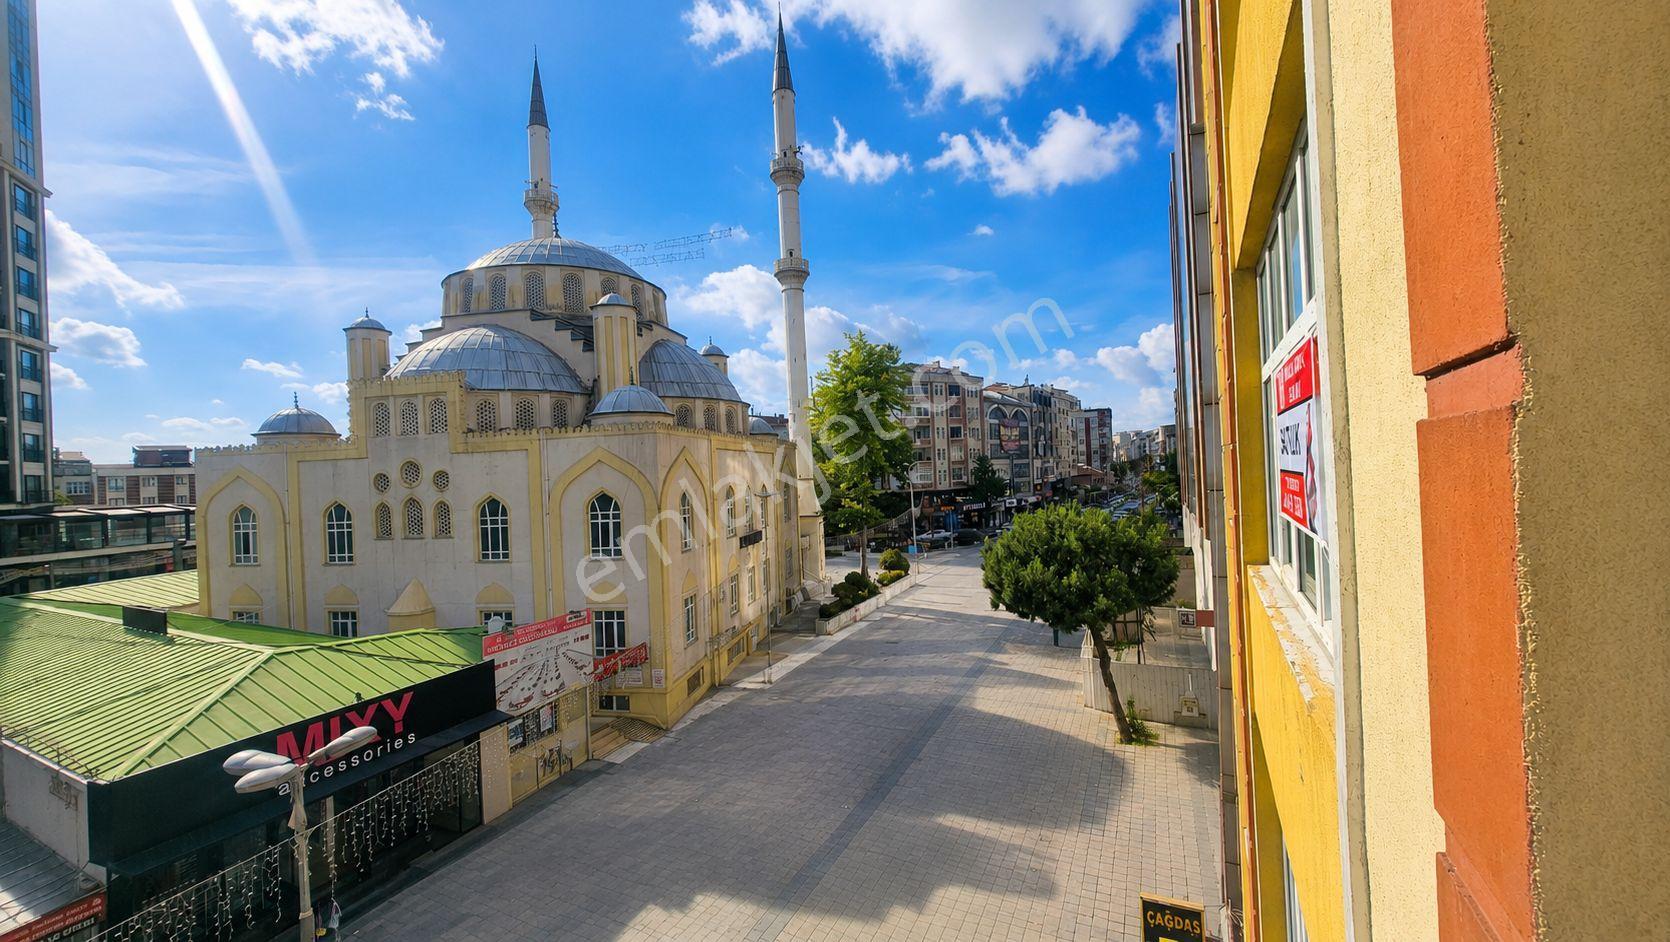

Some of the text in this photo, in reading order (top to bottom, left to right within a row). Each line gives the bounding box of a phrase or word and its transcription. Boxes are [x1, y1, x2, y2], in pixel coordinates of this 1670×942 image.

[276, 691, 414, 767] MIXY
[278, 732, 416, 796] acessories
[1146, 909, 1201, 937] ÇAĞDAŞ
